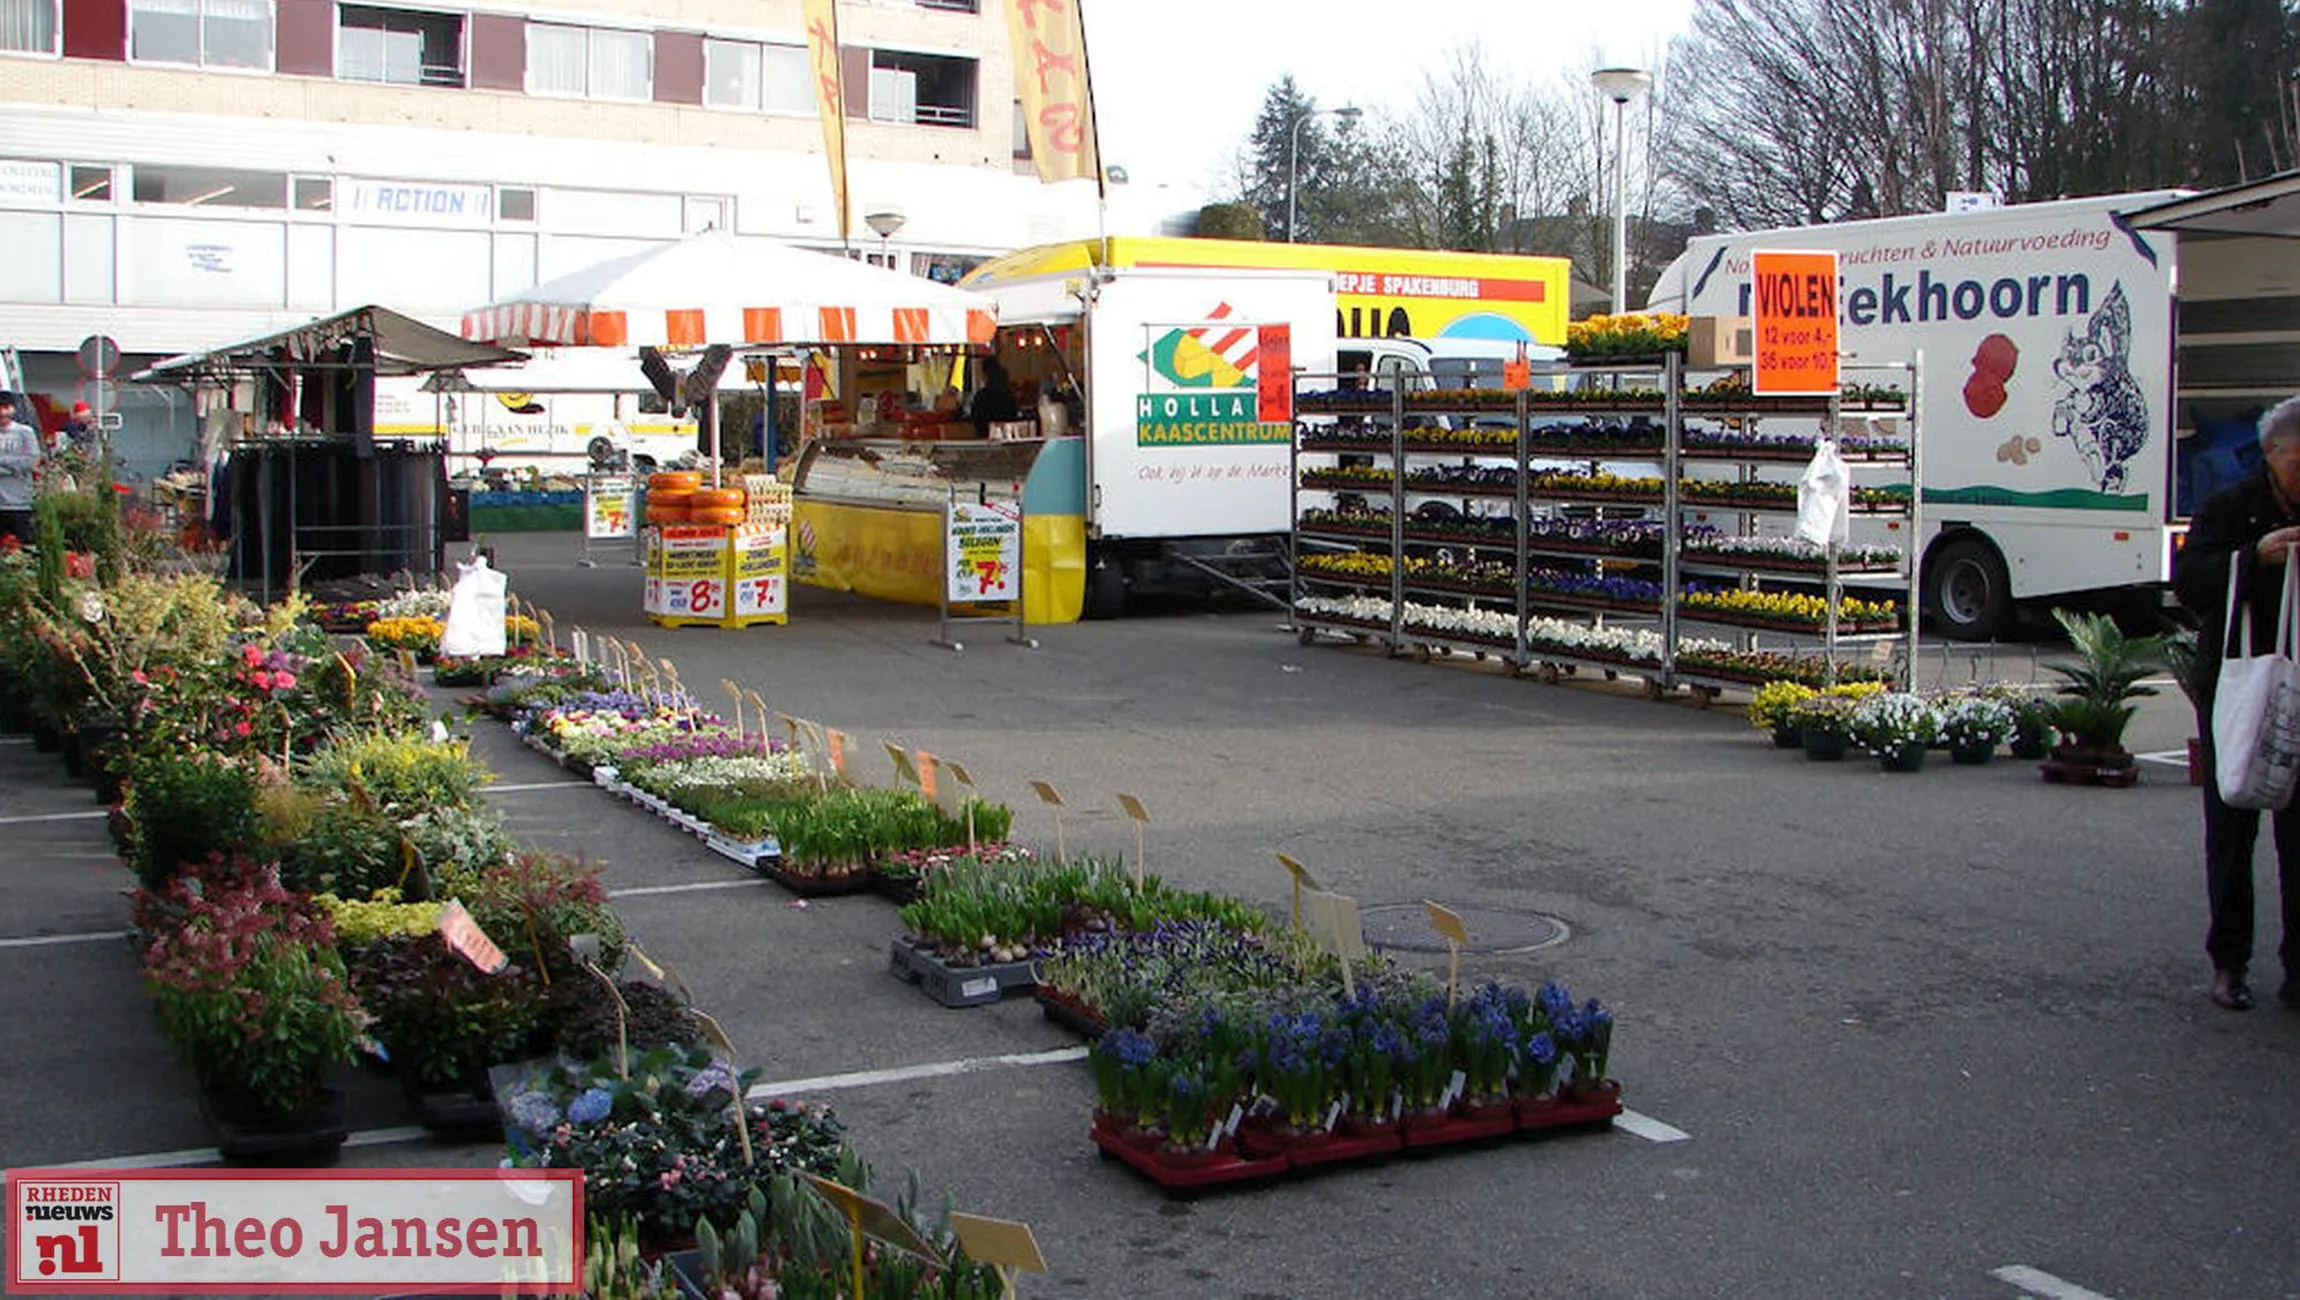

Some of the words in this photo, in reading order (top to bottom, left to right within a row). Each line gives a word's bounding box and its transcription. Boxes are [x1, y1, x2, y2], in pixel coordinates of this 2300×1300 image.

[376, 188, 465, 213] ACTION
[1839, 244, 1915, 265] ruchten
[1921, 239, 1937, 259] &
[1943, 228, 2111, 257] Natuurvoeding
[1336, 273, 1376, 293] EPJE
[1383, 275, 1479, 298] SPAKENBURG
[1757, 273, 1835, 318] VIOLEN
[1840, 269, 2090, 325] ekhoorn
[1764, 326, 1778, 344] 12
[1782, 331, 1810, 345] voor
[1781, 356, 1809, 370] voor
[1138, 397, 1257, 418] HOLLA
[1138, 420, 1291, 444] KAASCENTRUM
